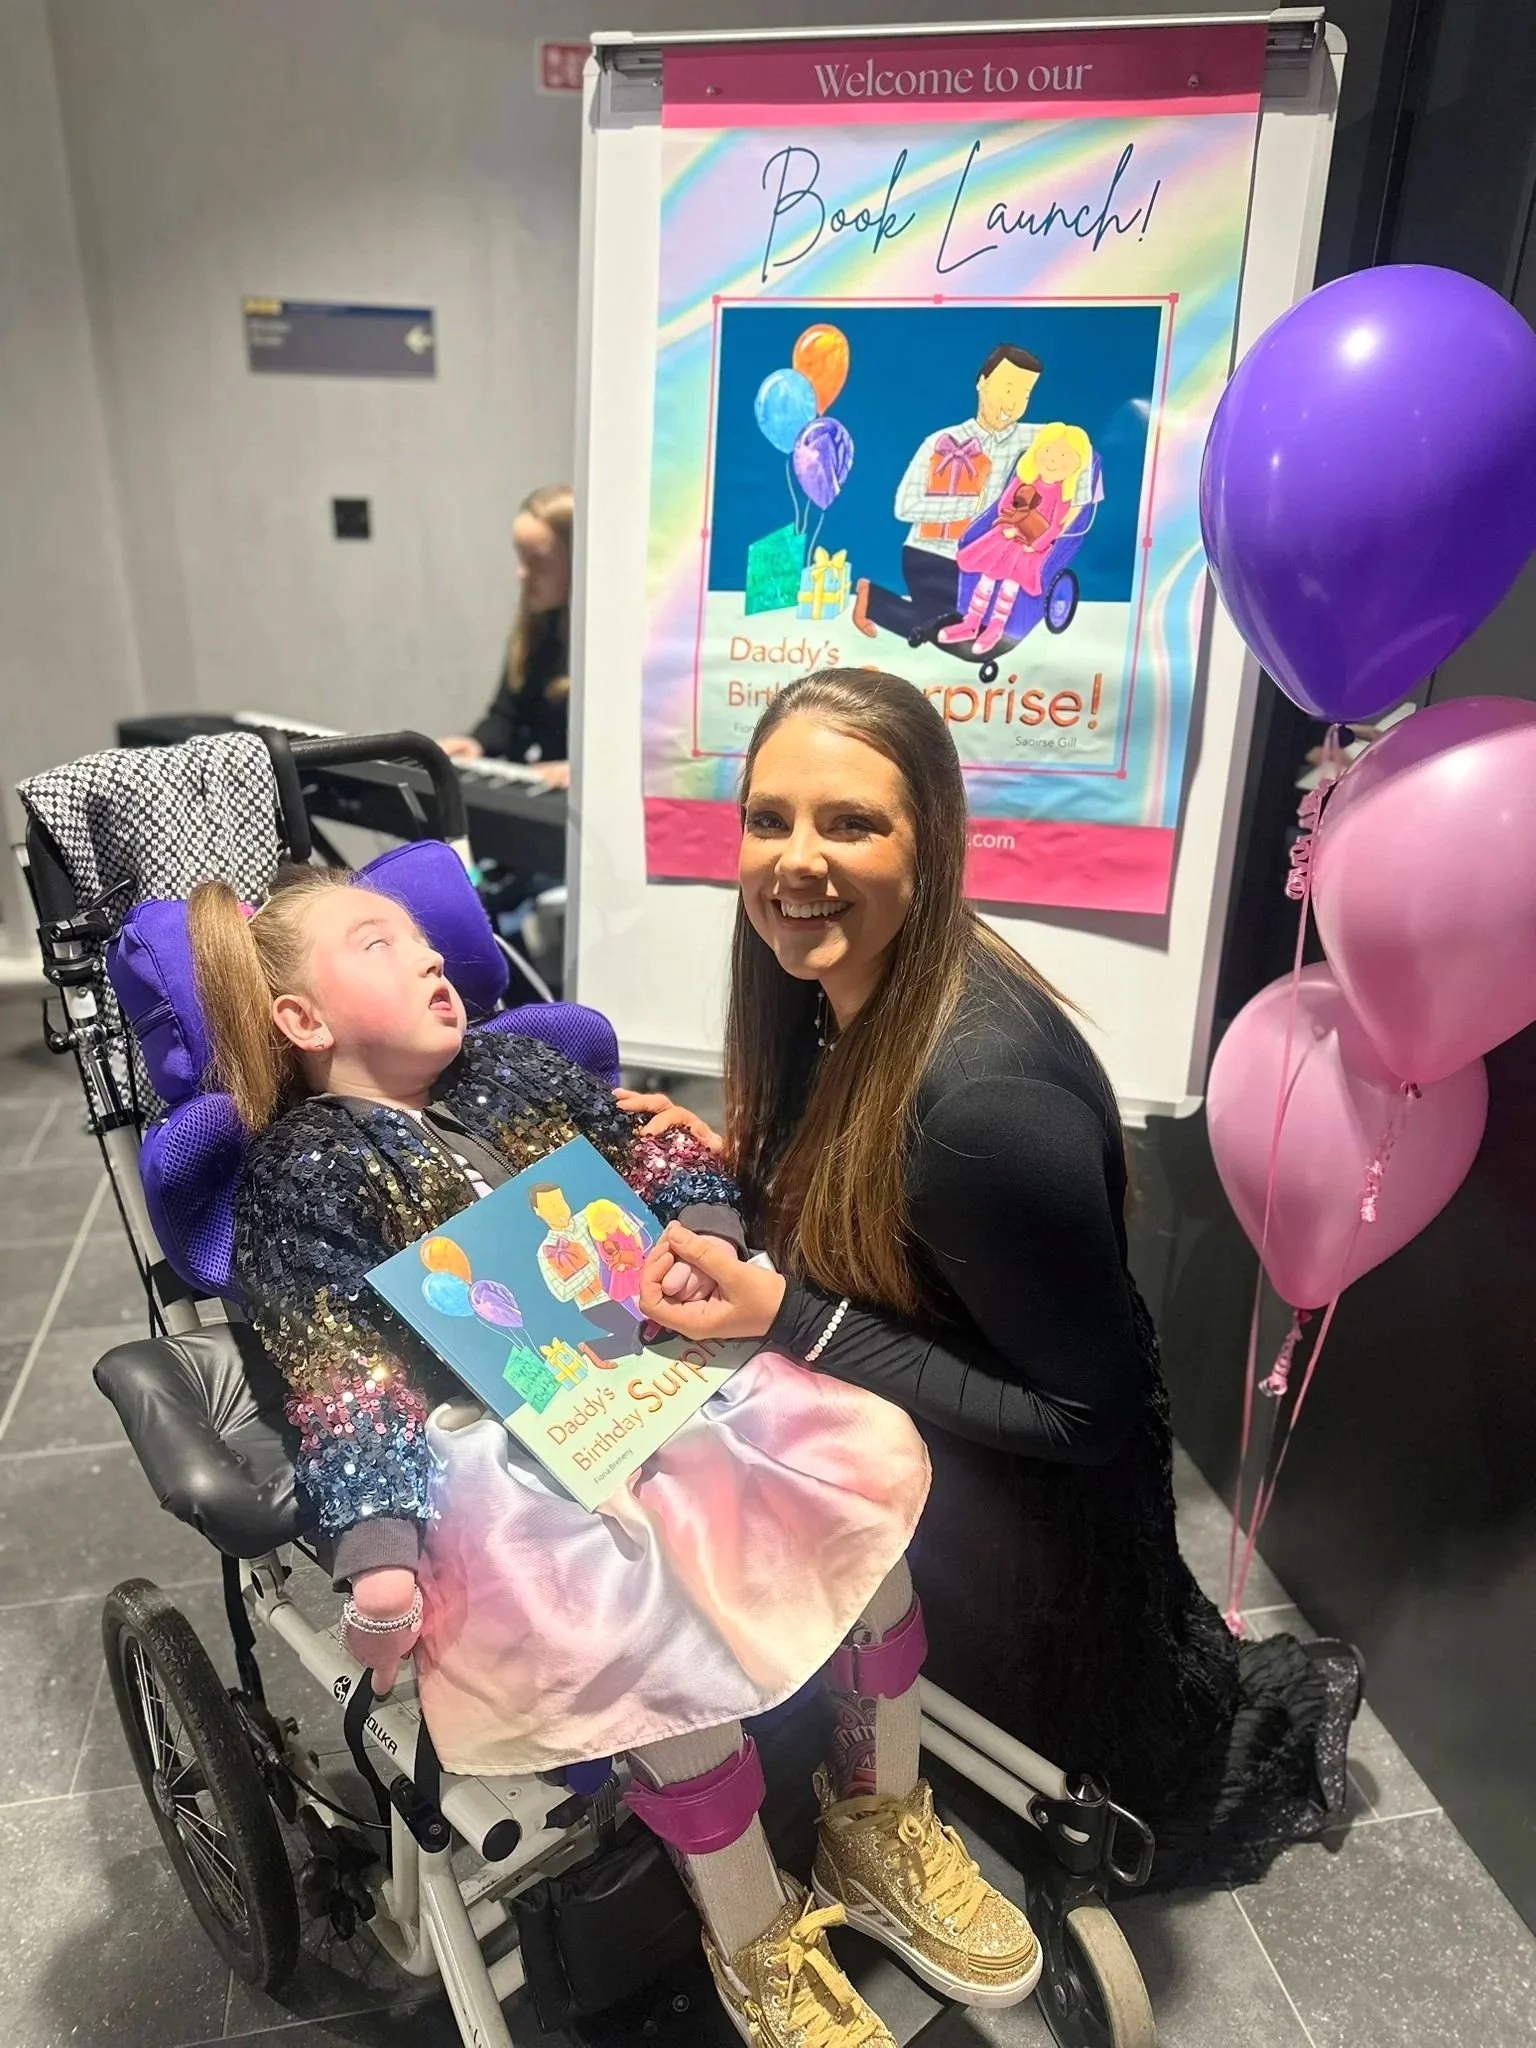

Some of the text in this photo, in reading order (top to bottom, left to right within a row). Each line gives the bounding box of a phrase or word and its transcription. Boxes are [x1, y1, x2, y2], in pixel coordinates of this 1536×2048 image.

[813, 59, 1093, 98] Welcome to our
[761, 140, 1162, 284] Book Launch!
[730, 636, 840, 672] Daddy's
[922, 671, 1104, 729] rprise!
[1015, 735, 1054, 748] Saoirse
[1057, 737, 1077, 748] Gill
[967, 832, 1015, 850] .com
[546, 1386, 616, 1446] Daddy's
[571, 1408, 645, 1473] Birthday
[593, 1447, 634, 1486] Fiona Breheny
[366, 1716, 398, 1755] OLLKA
